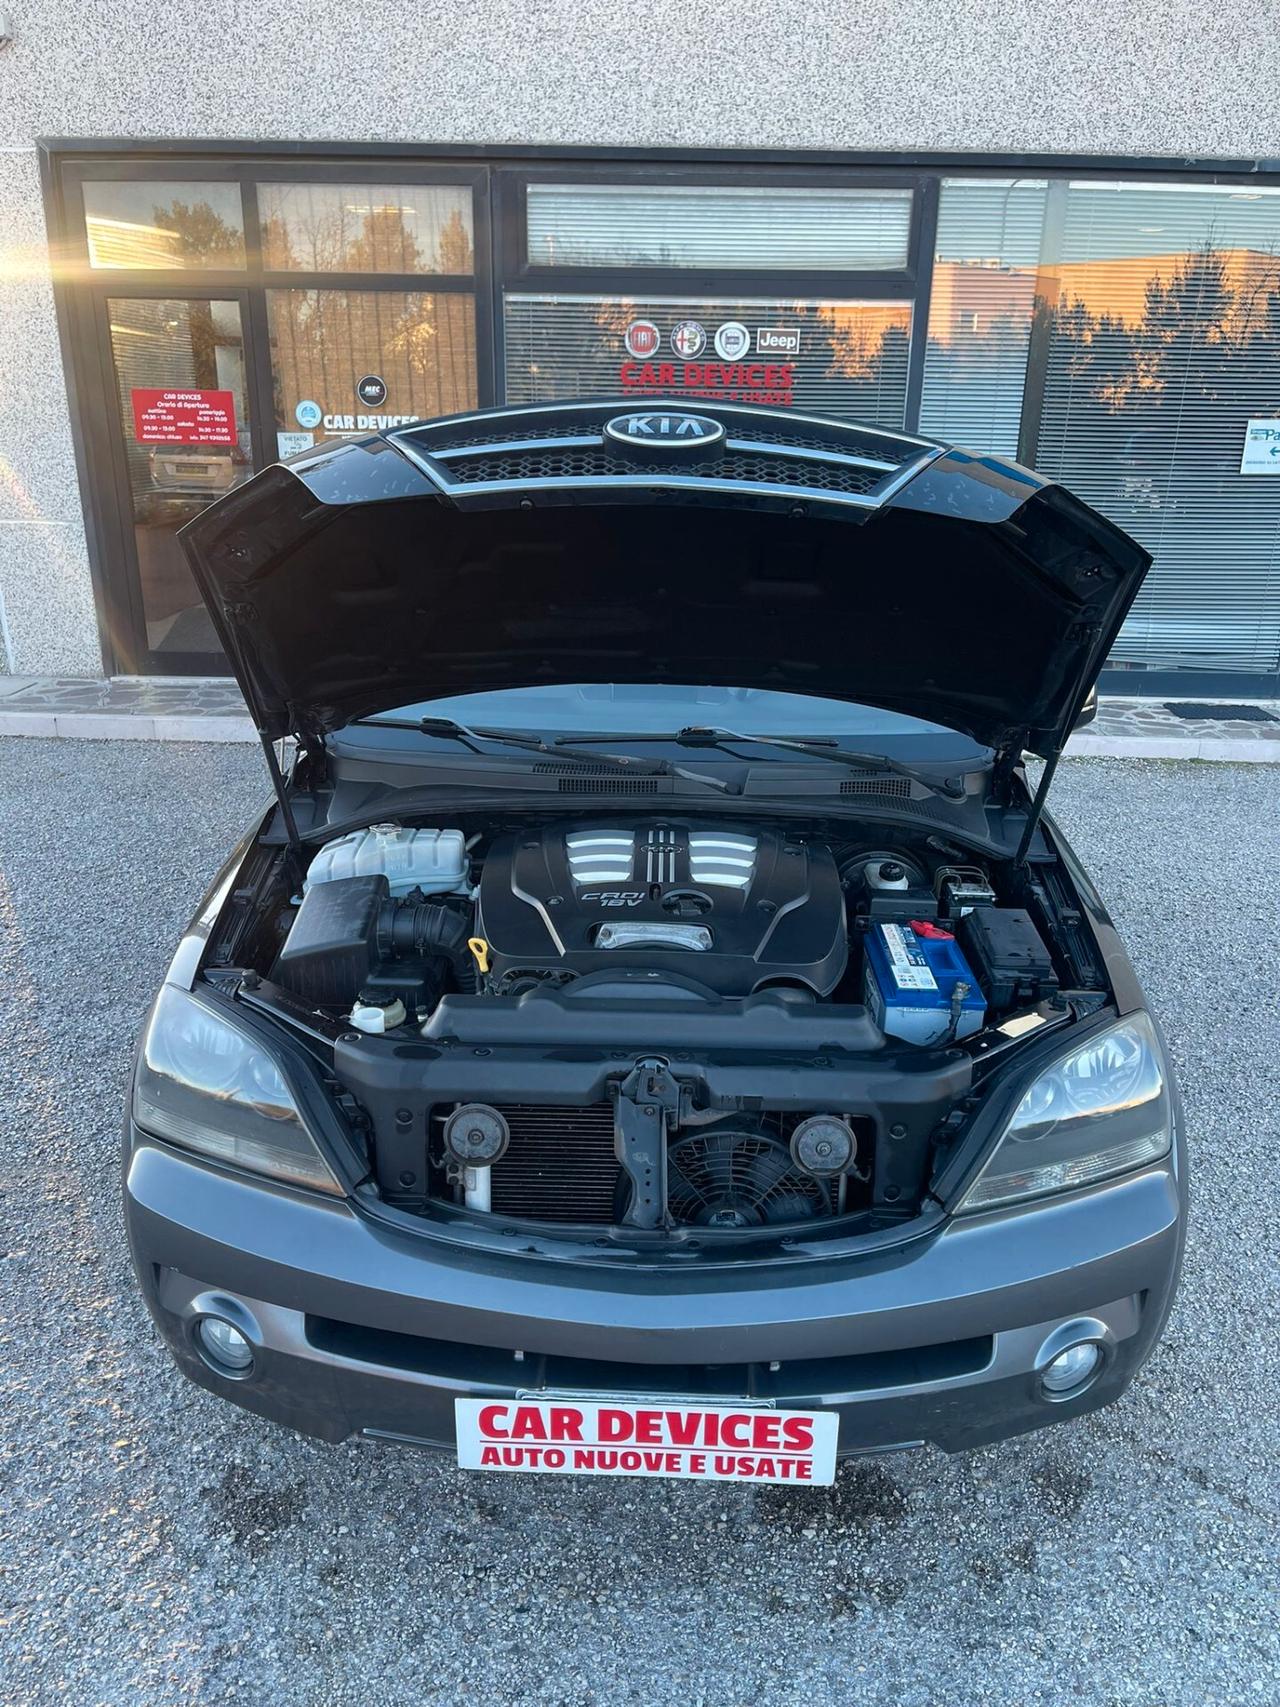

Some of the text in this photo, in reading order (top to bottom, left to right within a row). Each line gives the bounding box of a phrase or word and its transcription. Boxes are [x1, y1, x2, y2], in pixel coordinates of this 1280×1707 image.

[760, 333, 796, 349] Jeep
[620, 363, 793, 389] CAR DEVICES
[177, 393, 202, 401] DEVICES
[323, 415, 355, 429] CAR
[628, 417, 704, 436] KIA
[478, 1405, 814, 1450] CAR DEVICES
[481, 1446, 813, 1480] AUTO NUOVE E USATE
